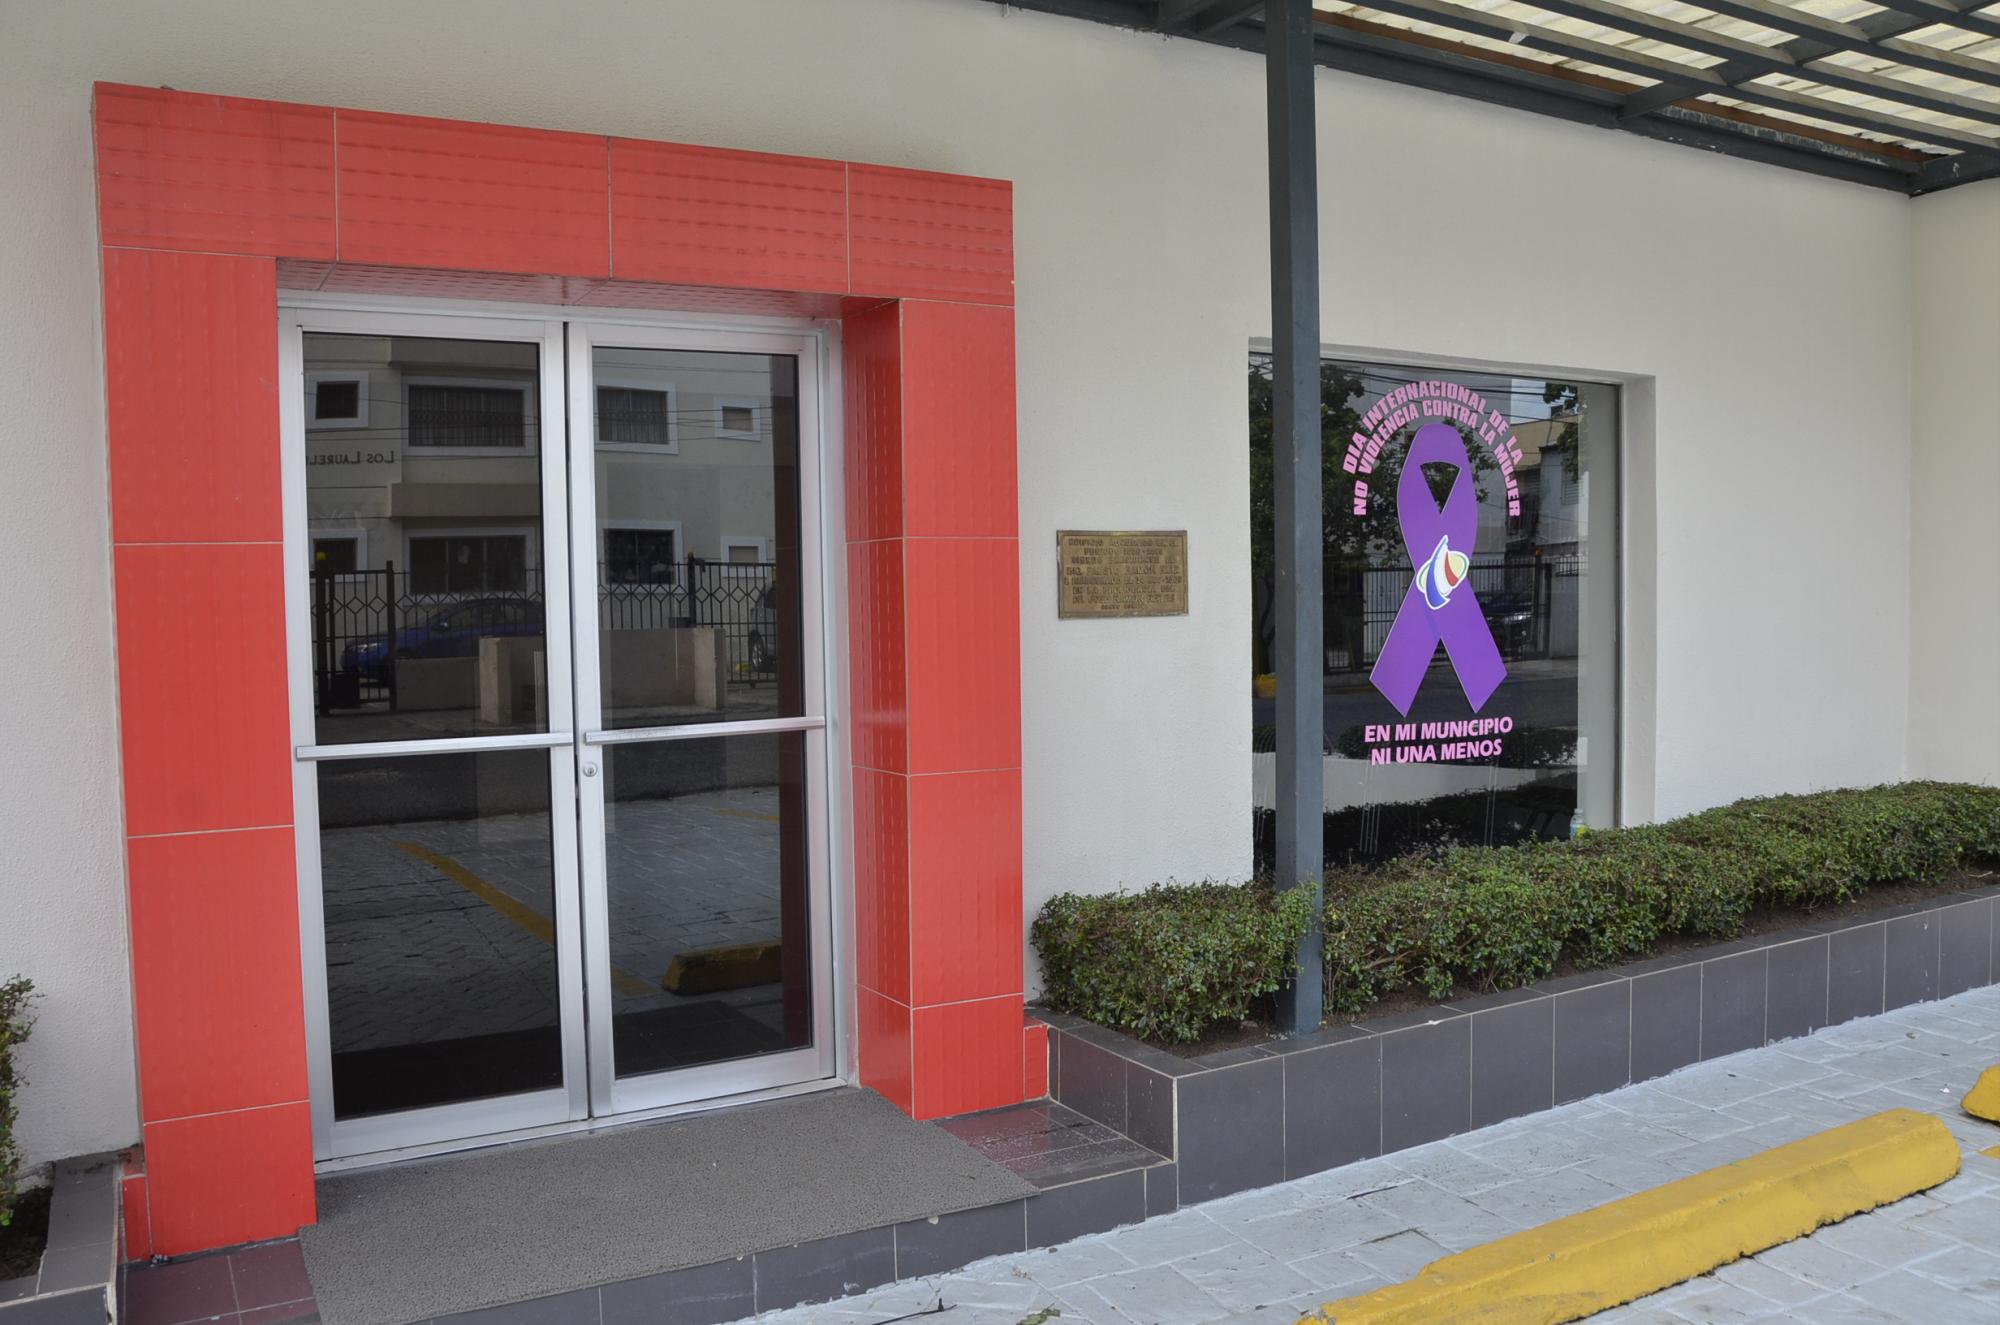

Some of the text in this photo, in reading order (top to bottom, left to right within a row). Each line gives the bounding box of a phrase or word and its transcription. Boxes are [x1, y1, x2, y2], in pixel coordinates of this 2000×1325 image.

[1342, 380, 1523, 475] DIA INTERNACIONAL DE LA
[1353, 400, 1521, 517] NO VIOLENCIA CONTRA LA MUJER
[1364, 716, 1514, 743] EN MI MUNICIPIO
[1371, 738, 1503, 766] NI UNA MENOS
